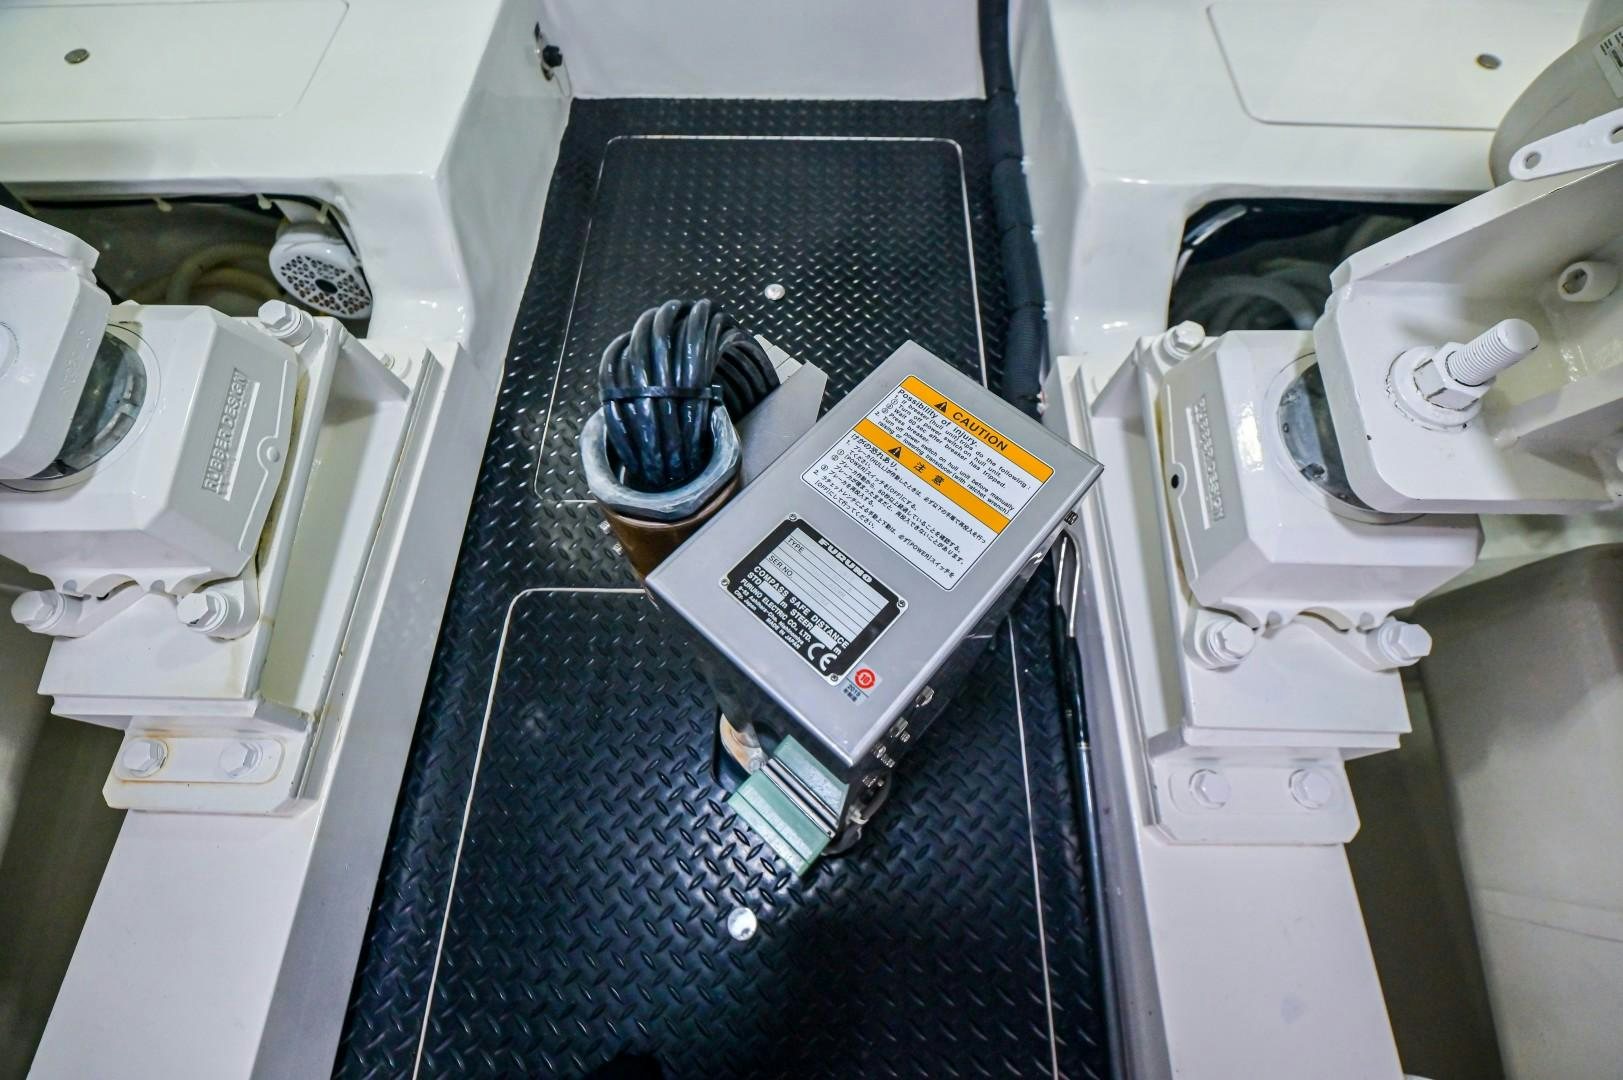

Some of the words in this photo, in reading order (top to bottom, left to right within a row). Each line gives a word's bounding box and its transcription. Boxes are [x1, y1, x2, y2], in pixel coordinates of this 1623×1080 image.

[201, 430, 232, 494] RUBBER
[221, 368, 249, 431] DESIGN
[888, 412, 905, 426] Press
[893, 408, 907, 419] Wait
[915, 424, 927, 433] sec
[928, 432, 942, 444] after
[943, 443, 967, 461] breaker
[968, 460, 981, 470] has
[981, 470, 1007, 489] tripped.
[896, 388, 939, 419] Possibility
[939, 417, 951, 427] of
[951, 426, 980, 448] injury.
[897, 404, 912, 415] Turn
[912, 414, 922, 422] off
[922, 422, 941, 436] power
[942, 435, 963, 451] switch
[973, 456, 986, 466] hull
[907, 404, 930, 420] breaker
[929, 418, 944, 430] (hull
[944, 429, 960, 441] unit)
[958, 438, 974, 451] trips
[975, 449, 984, 457] do
[985, 457, 997, 466] the
[951, 410, 1008, 451] CAUTION
[877, 420, 895, 434] raising
[901, 438, 924, 455] lowering
[924, 453, 952, 475] transducer
[951, 472, 966, 484] (with
[966, 483, 986, 498] ratchet
[882, 416, 895, 426] Turn
[903, 431, 920, 445] power
[920, 443, 938, 457] switch
[947, 461, 959, 471] hull
[958, 469, 971, 479] unit
[970, 478, 989, 492] before
[989, 491, 1015, 511] manually
[786, 537, 804, 553] TYPE
[817, 537, 874, 583] FURUNO
[740, 577, 763, 598] FURUNO
[761, 596, 788, 621] ELECTRIC
[798, 628, 813, 642] LTD.
[743, 597, 757, 611] Japan
[746, 570, 762, 585] STD
[779, 600, 788, 609] m
[788, 607, 814, 630] STEER
[832, 646, 842, 655] m
[752, 564, 789, 597] COMPASS
[788, 595, 811, 615] SAFE
[810, 614, 849, 649] DISTANCE
[765, 616, 779, 630] MADE
[778, 628, 785, 636] IN
[783, 633, 801, 650] JAPAN
